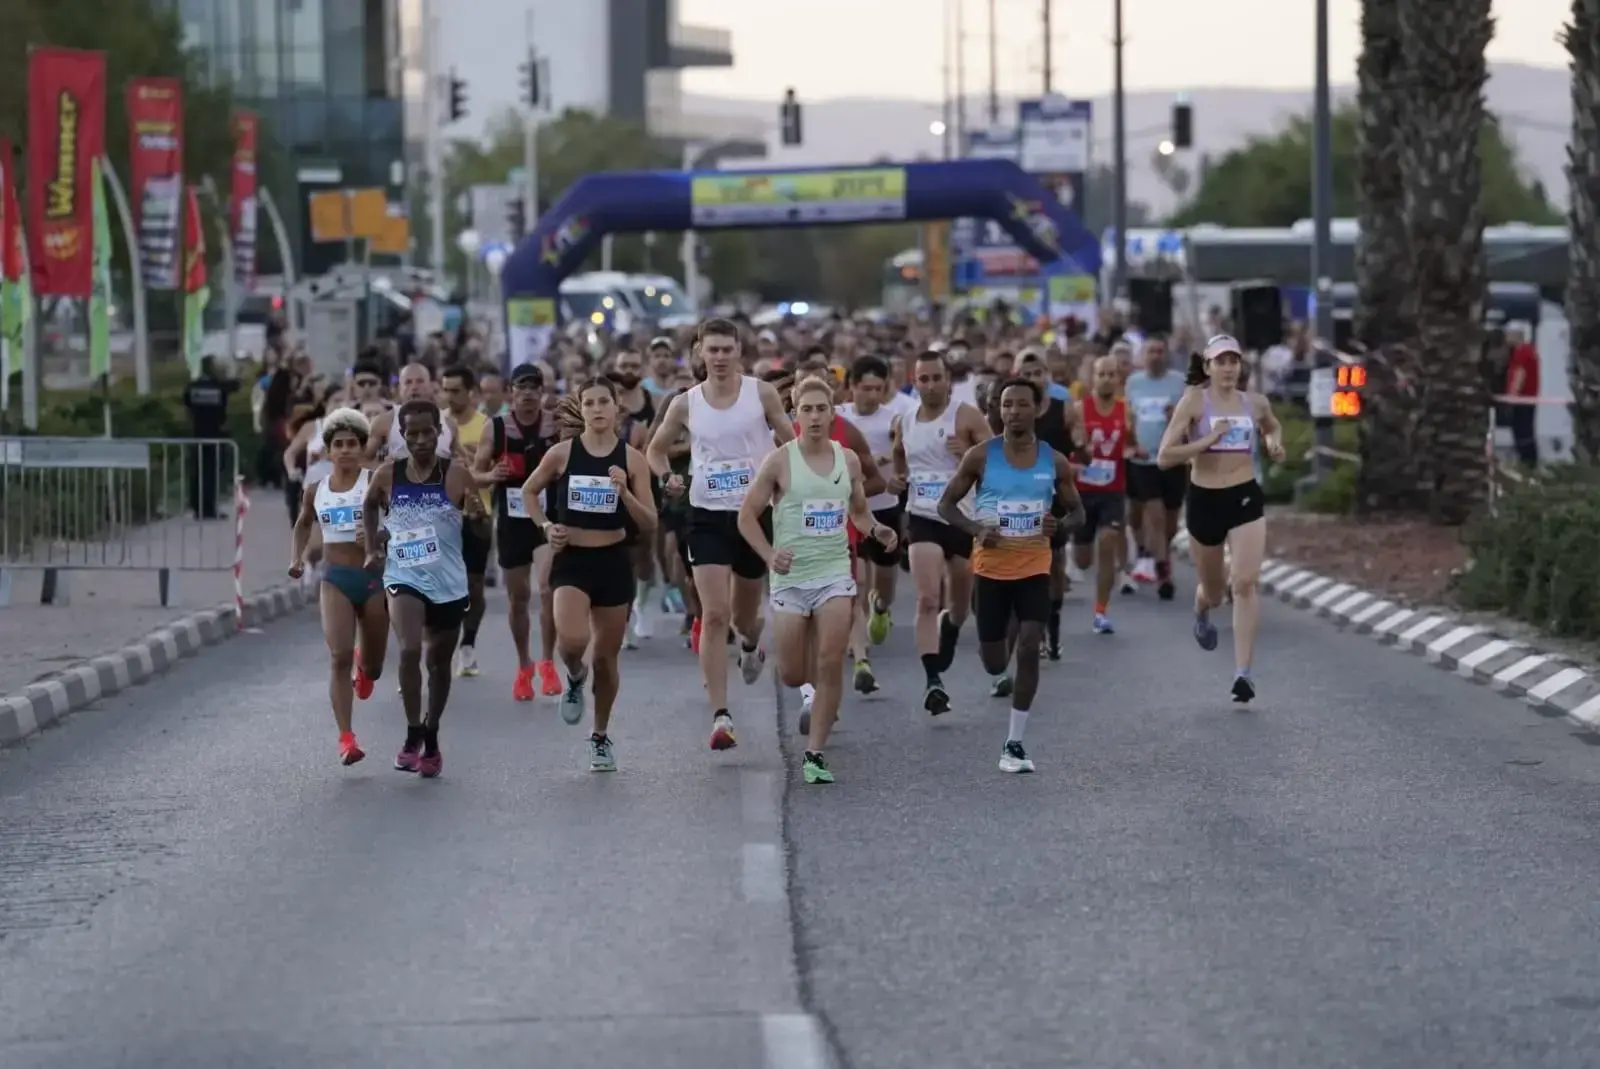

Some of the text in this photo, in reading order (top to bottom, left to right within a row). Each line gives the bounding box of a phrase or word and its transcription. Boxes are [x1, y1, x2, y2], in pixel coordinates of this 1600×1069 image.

[45, 90, 77, 218] Winner
[336, 510, 346, 523] 2
[404, 543, 426, 559] 1298
